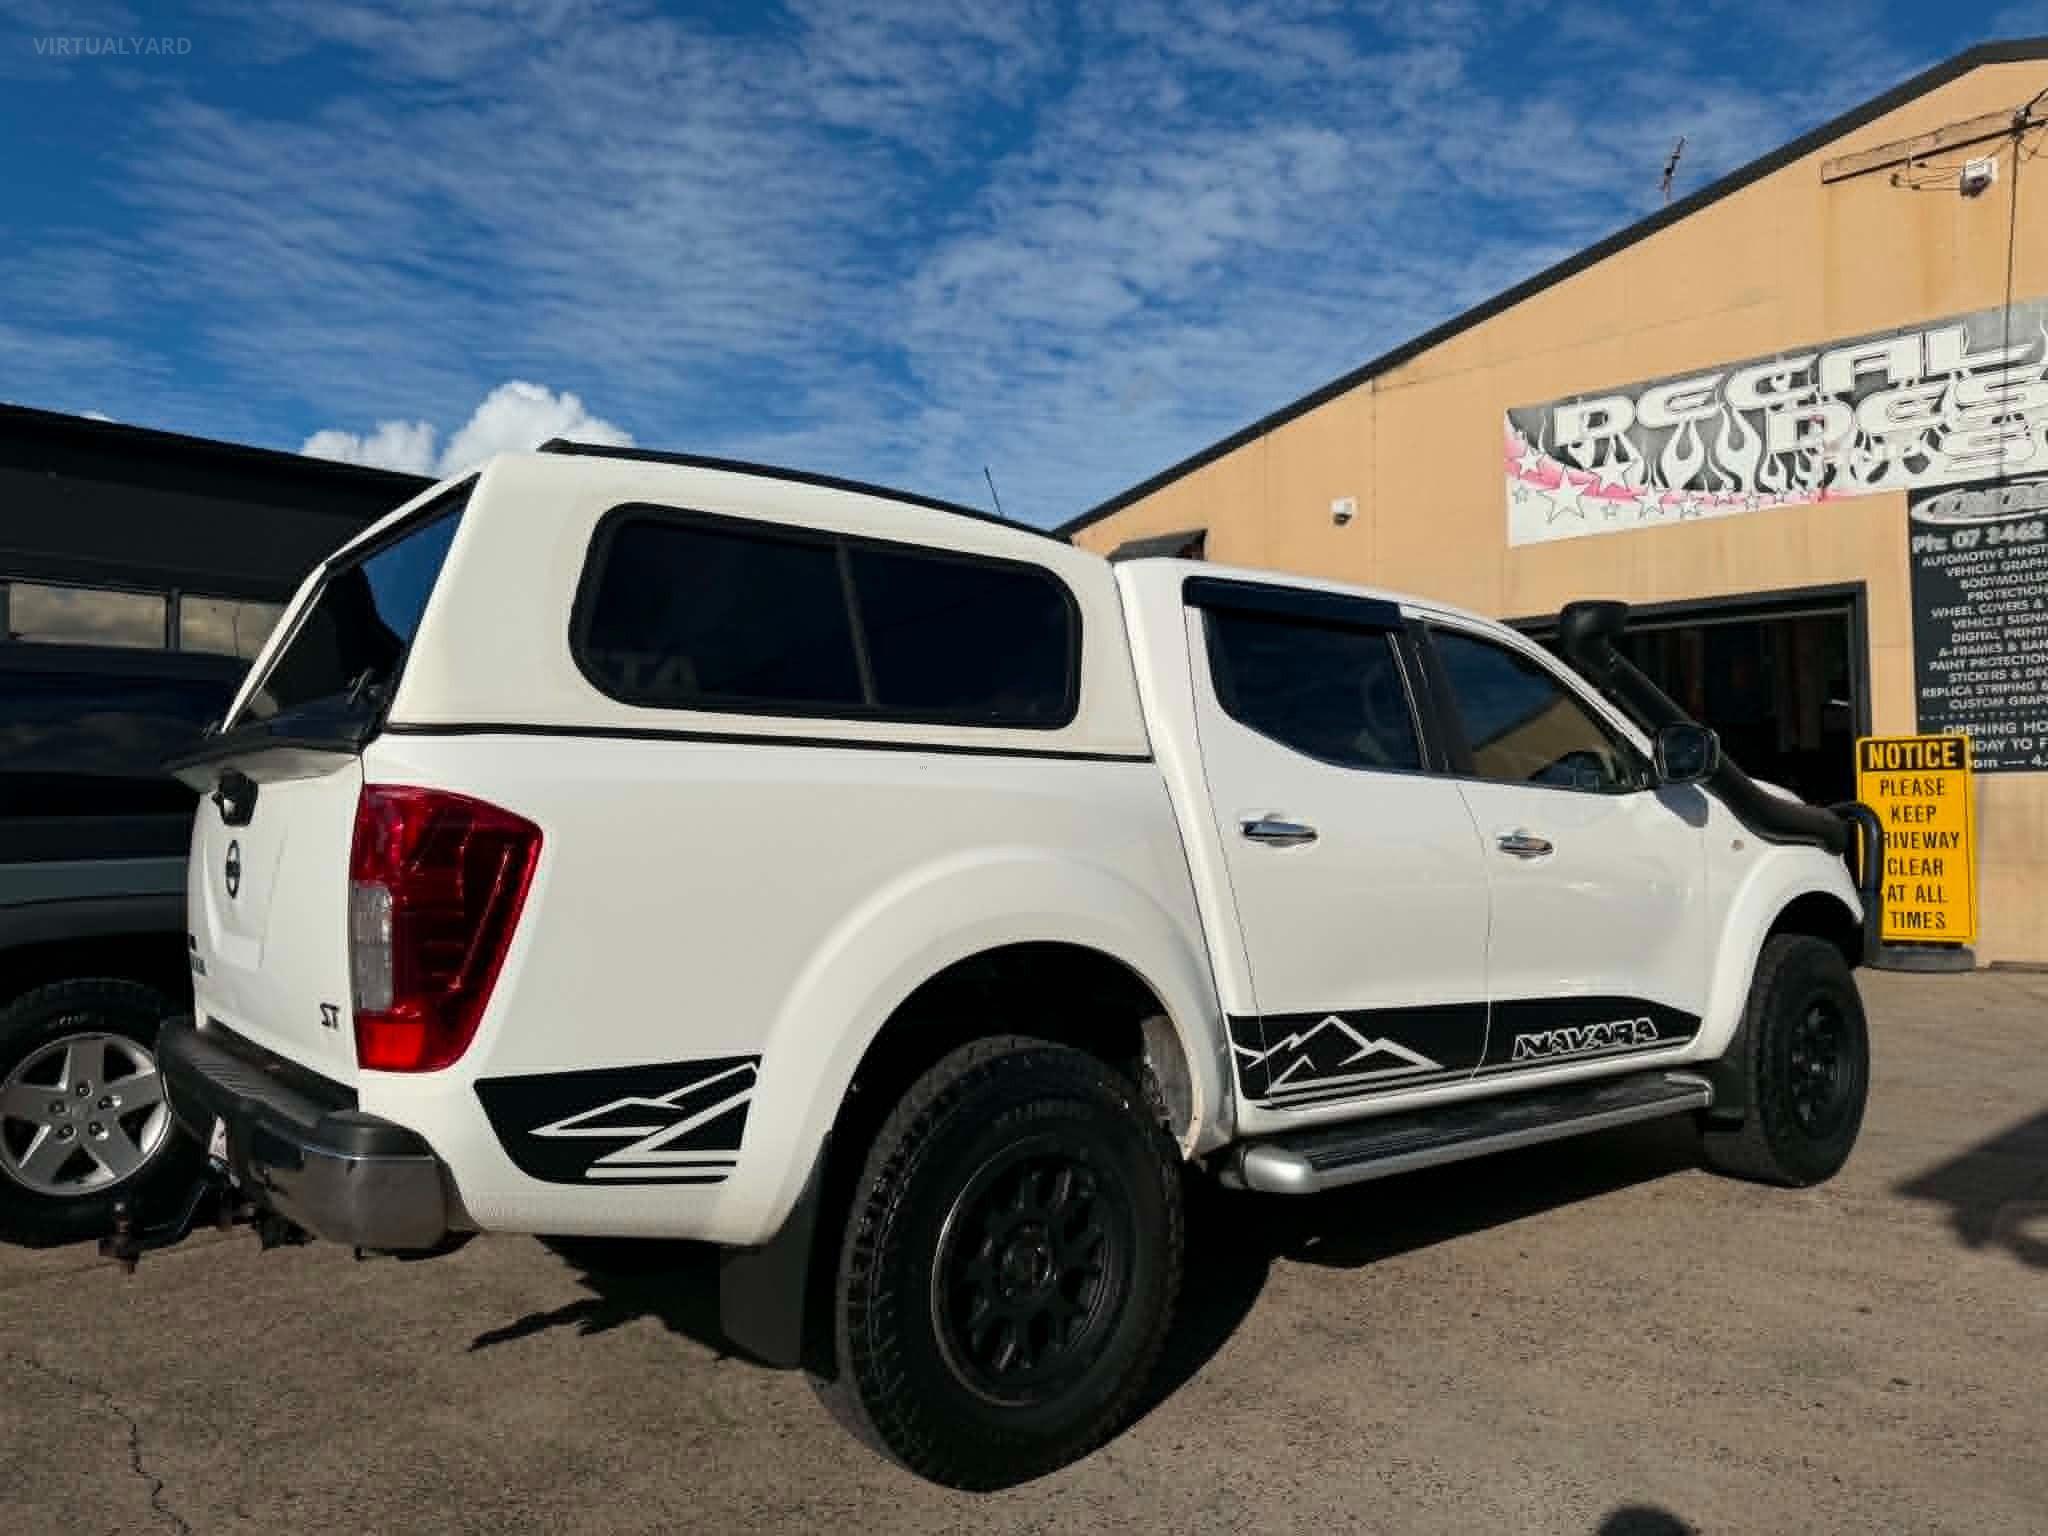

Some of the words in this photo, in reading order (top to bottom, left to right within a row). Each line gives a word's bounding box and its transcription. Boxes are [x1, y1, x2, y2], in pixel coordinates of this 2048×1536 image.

[1553, 325, 2036, 447] DECAL
[1951, 527, 1980, 549] 07
[1922, 549, 2004, 567] AUTOMOTIVE
[1944, 562, 1997, 577] VEHICLE
[1930, 607, 1976, 619] WHEEL
[1978, 600, 2029, 614] COVERS
[1951, 615, 2003, 630] VEHICLE
[1951, 631, 2001, 644] DIGITAL
[1928, 658, 1967, 672] PAINT
[1948, 670, 2007, 683] STICKERS
[1921, 686, 1973, 697] REPLICA
[1949, 696, 2004, 710] CUSTOM
[1943, 722, 2017, 737] OPENING
[2010, 737, 2033, 752] TO
[1869, 741, 1957, 769] NOTICE
[1880, 778, 1945, 798] PLEASE
[1890, 804, 1937, 824] KEEP
[1883, 831, 1960, 849] RIVEWAY
[1887, 857, 1944, 877] CLEAR
[1887, 884, 1906, 903] AT
[1915, 884, 1948, 904] ALL
[1890, 911, 1947, 930] TIMES
[319, 1001, 341, 1030] ST
[1511, 1016, 1659, 1060] NAVARA
